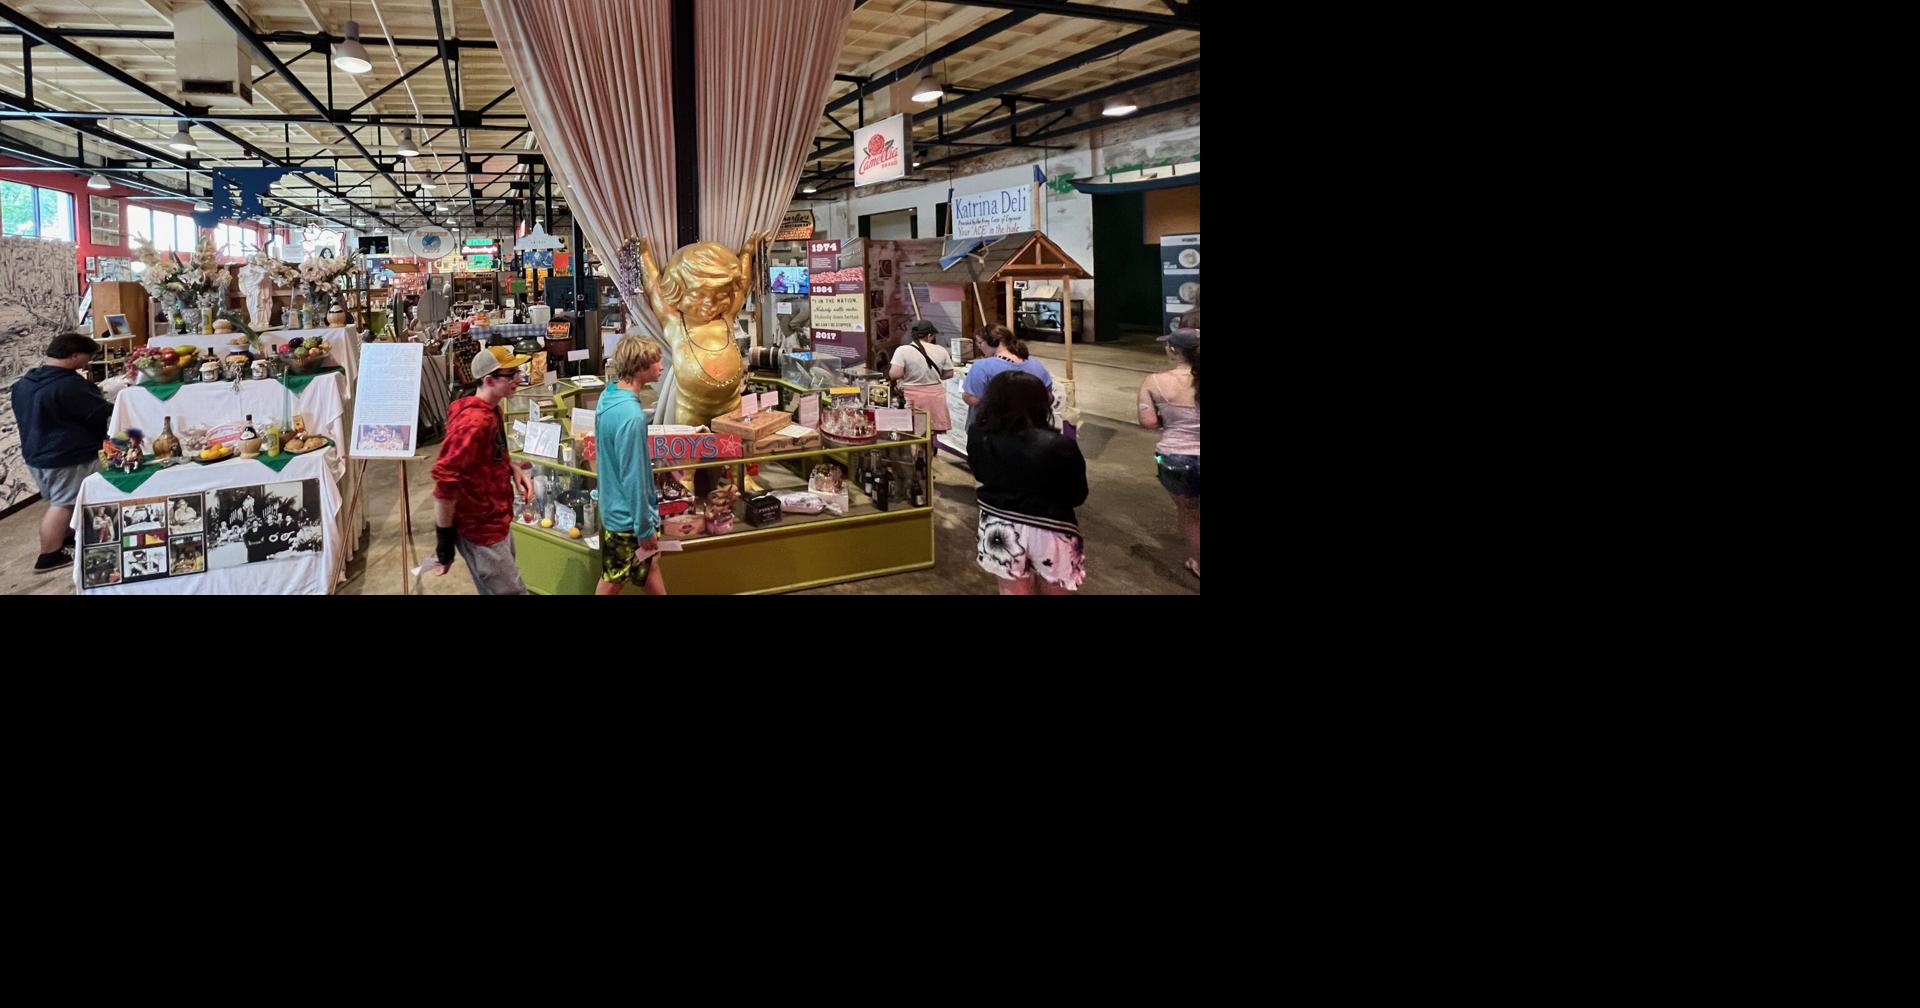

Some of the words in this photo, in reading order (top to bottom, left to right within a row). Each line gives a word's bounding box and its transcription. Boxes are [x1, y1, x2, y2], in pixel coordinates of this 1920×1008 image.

[859, 147, 898, 175] Camellia
[955, 195, 998, 219] Katrina
[1001, 187, 1026, 214] Deli
[811, 243, 837, 252] 1974
[815, 331, 837, 340] 2017
[653, 434, 719, 459] BOYS
